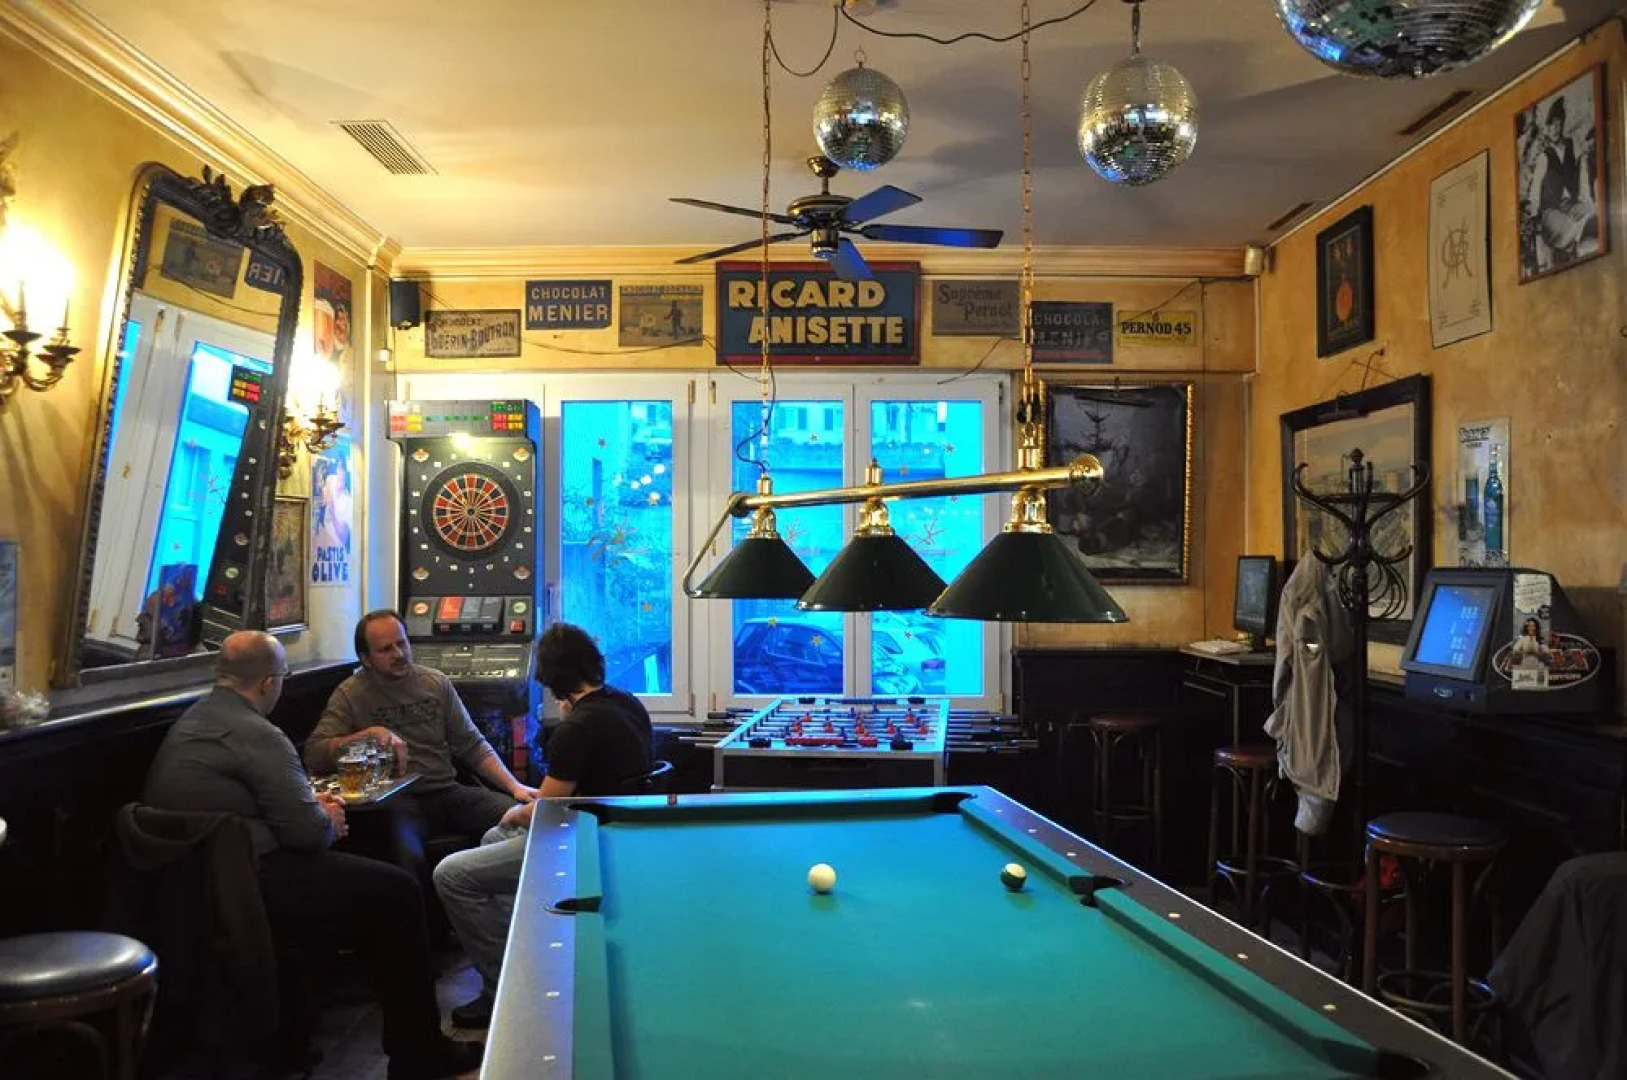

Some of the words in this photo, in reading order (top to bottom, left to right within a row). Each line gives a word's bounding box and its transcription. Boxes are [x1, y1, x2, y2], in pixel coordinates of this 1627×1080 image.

[531, 286, 606, 300] CHOCOLAT
[728, 280, 886, 308] RICARD
[528, 303, 608, 322] MENIER
[748, 316, 904, 344] ANISETTE
[1120, 321, 1172, 334] PERNOD
[1174, 321, 1192, 335] 45
[312, 562, 349, 582] OLIVE
